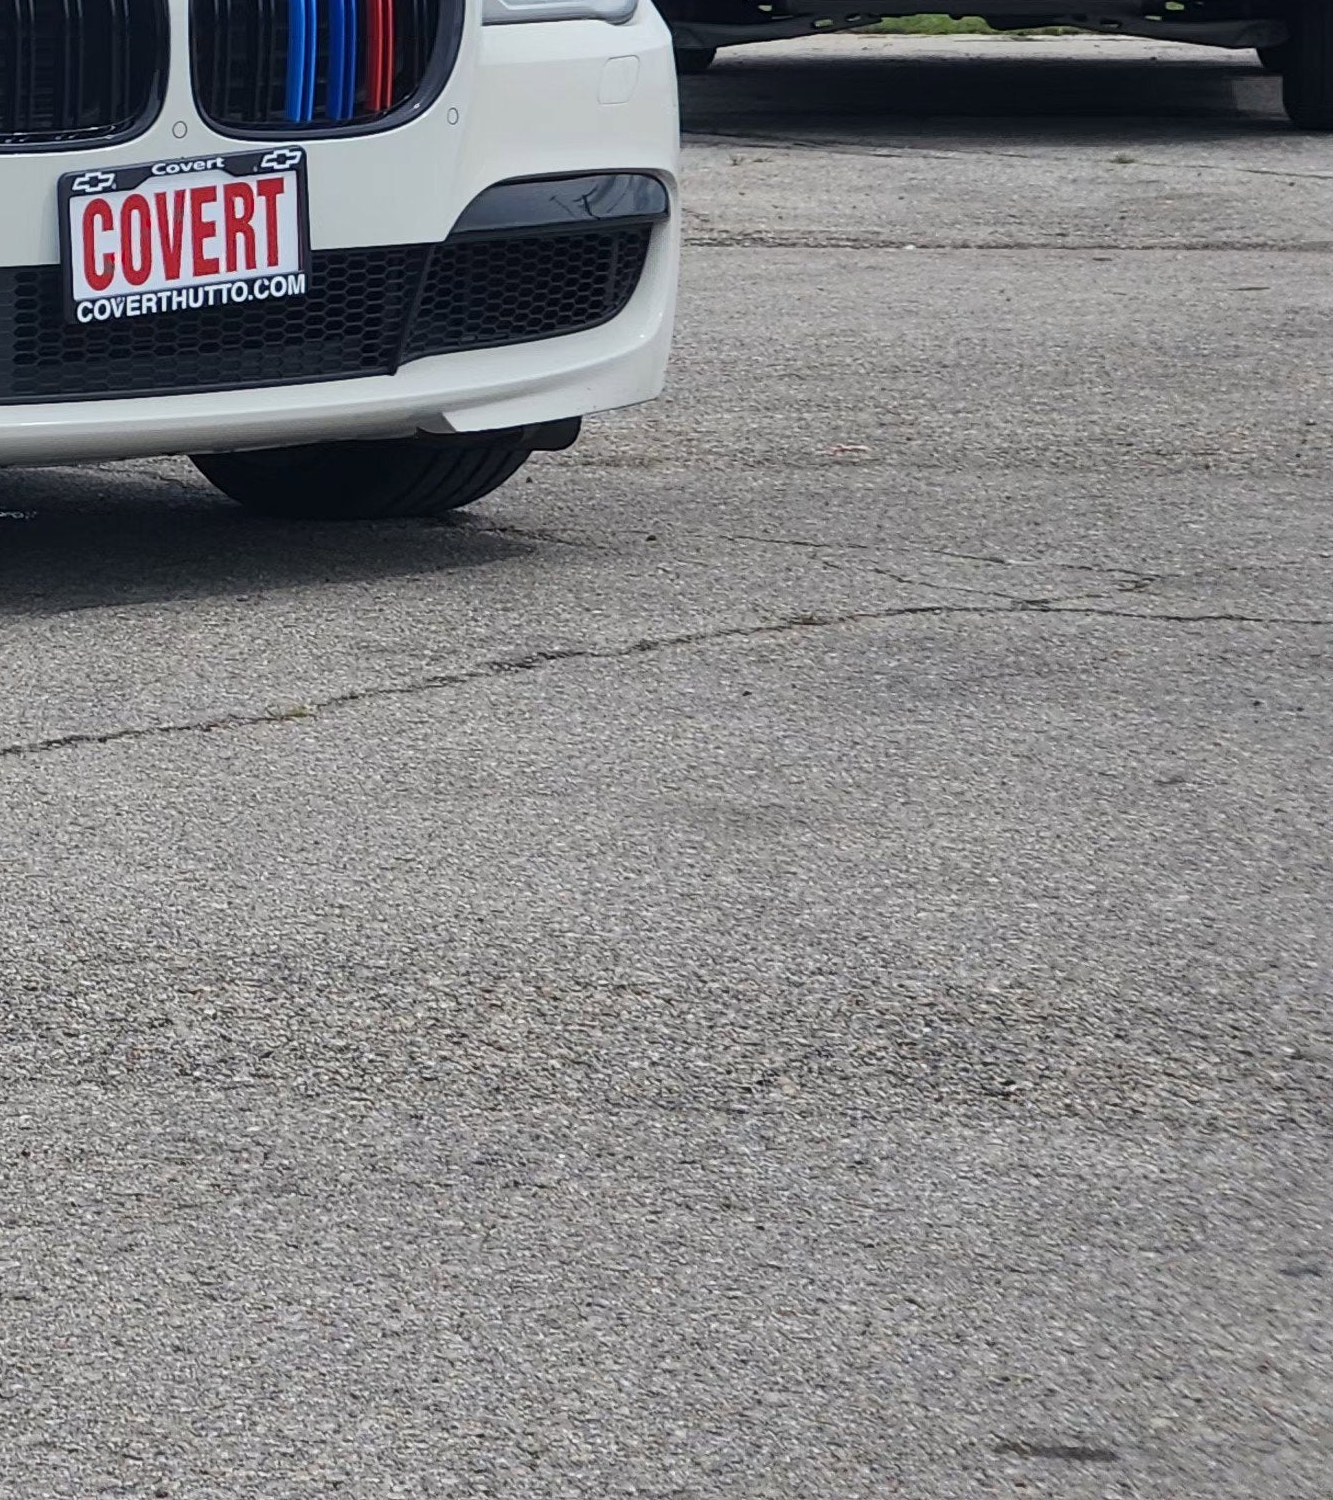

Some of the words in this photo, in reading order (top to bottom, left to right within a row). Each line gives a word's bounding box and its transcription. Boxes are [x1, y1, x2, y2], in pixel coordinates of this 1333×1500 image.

[151, 157, 225, 176] Covert
[83, 177, 284, 291] COVERT
[77, 274, 305, 323] COVERTHUTTO.COM
